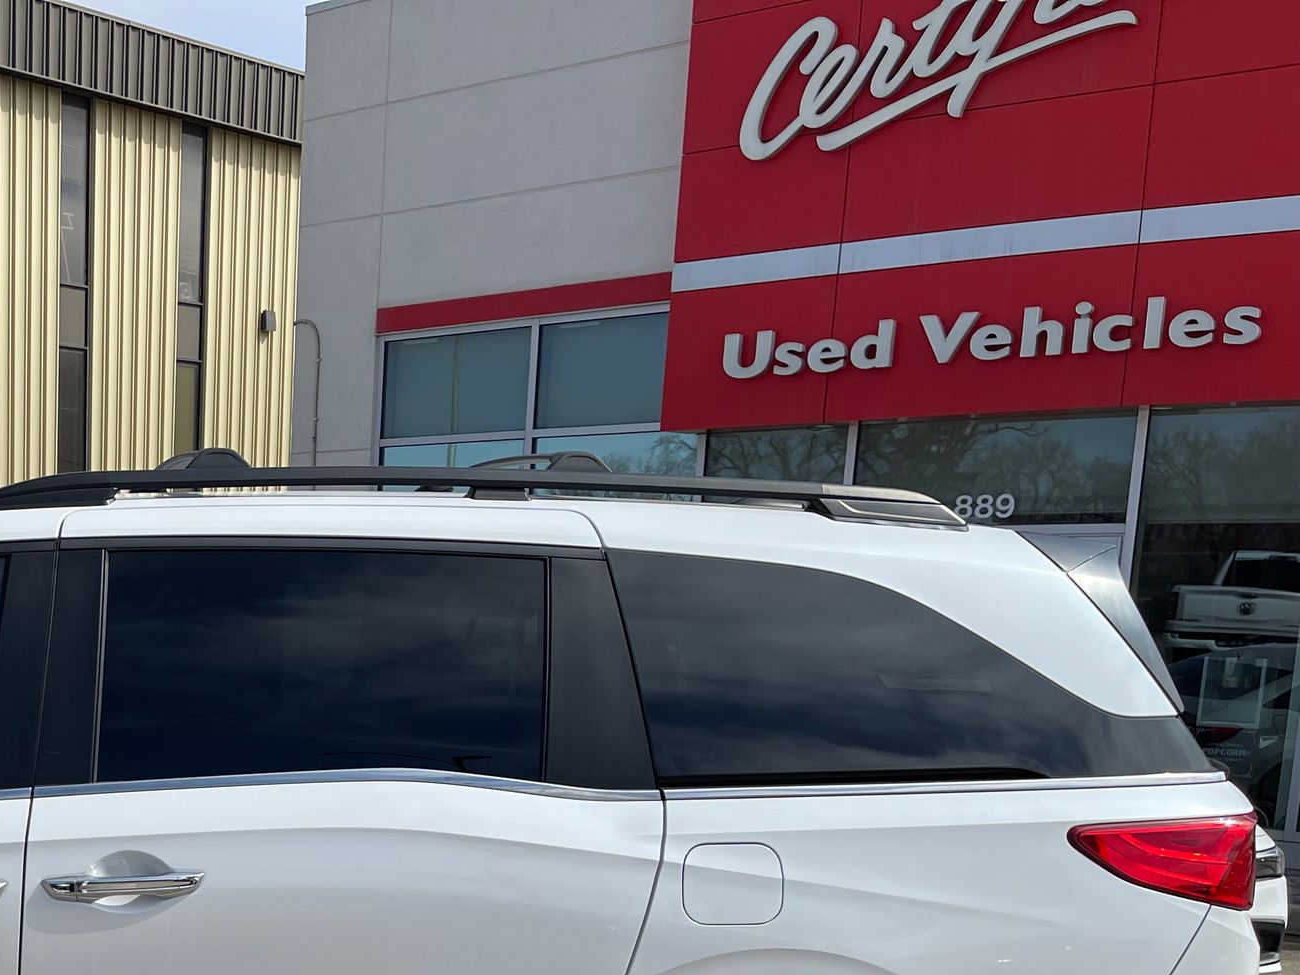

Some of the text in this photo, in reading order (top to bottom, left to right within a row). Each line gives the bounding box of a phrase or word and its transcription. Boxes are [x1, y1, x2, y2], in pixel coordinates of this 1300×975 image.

[722, 296, 1262, 379] Used Vehicles
[954, 493, 1016, 519] 889
